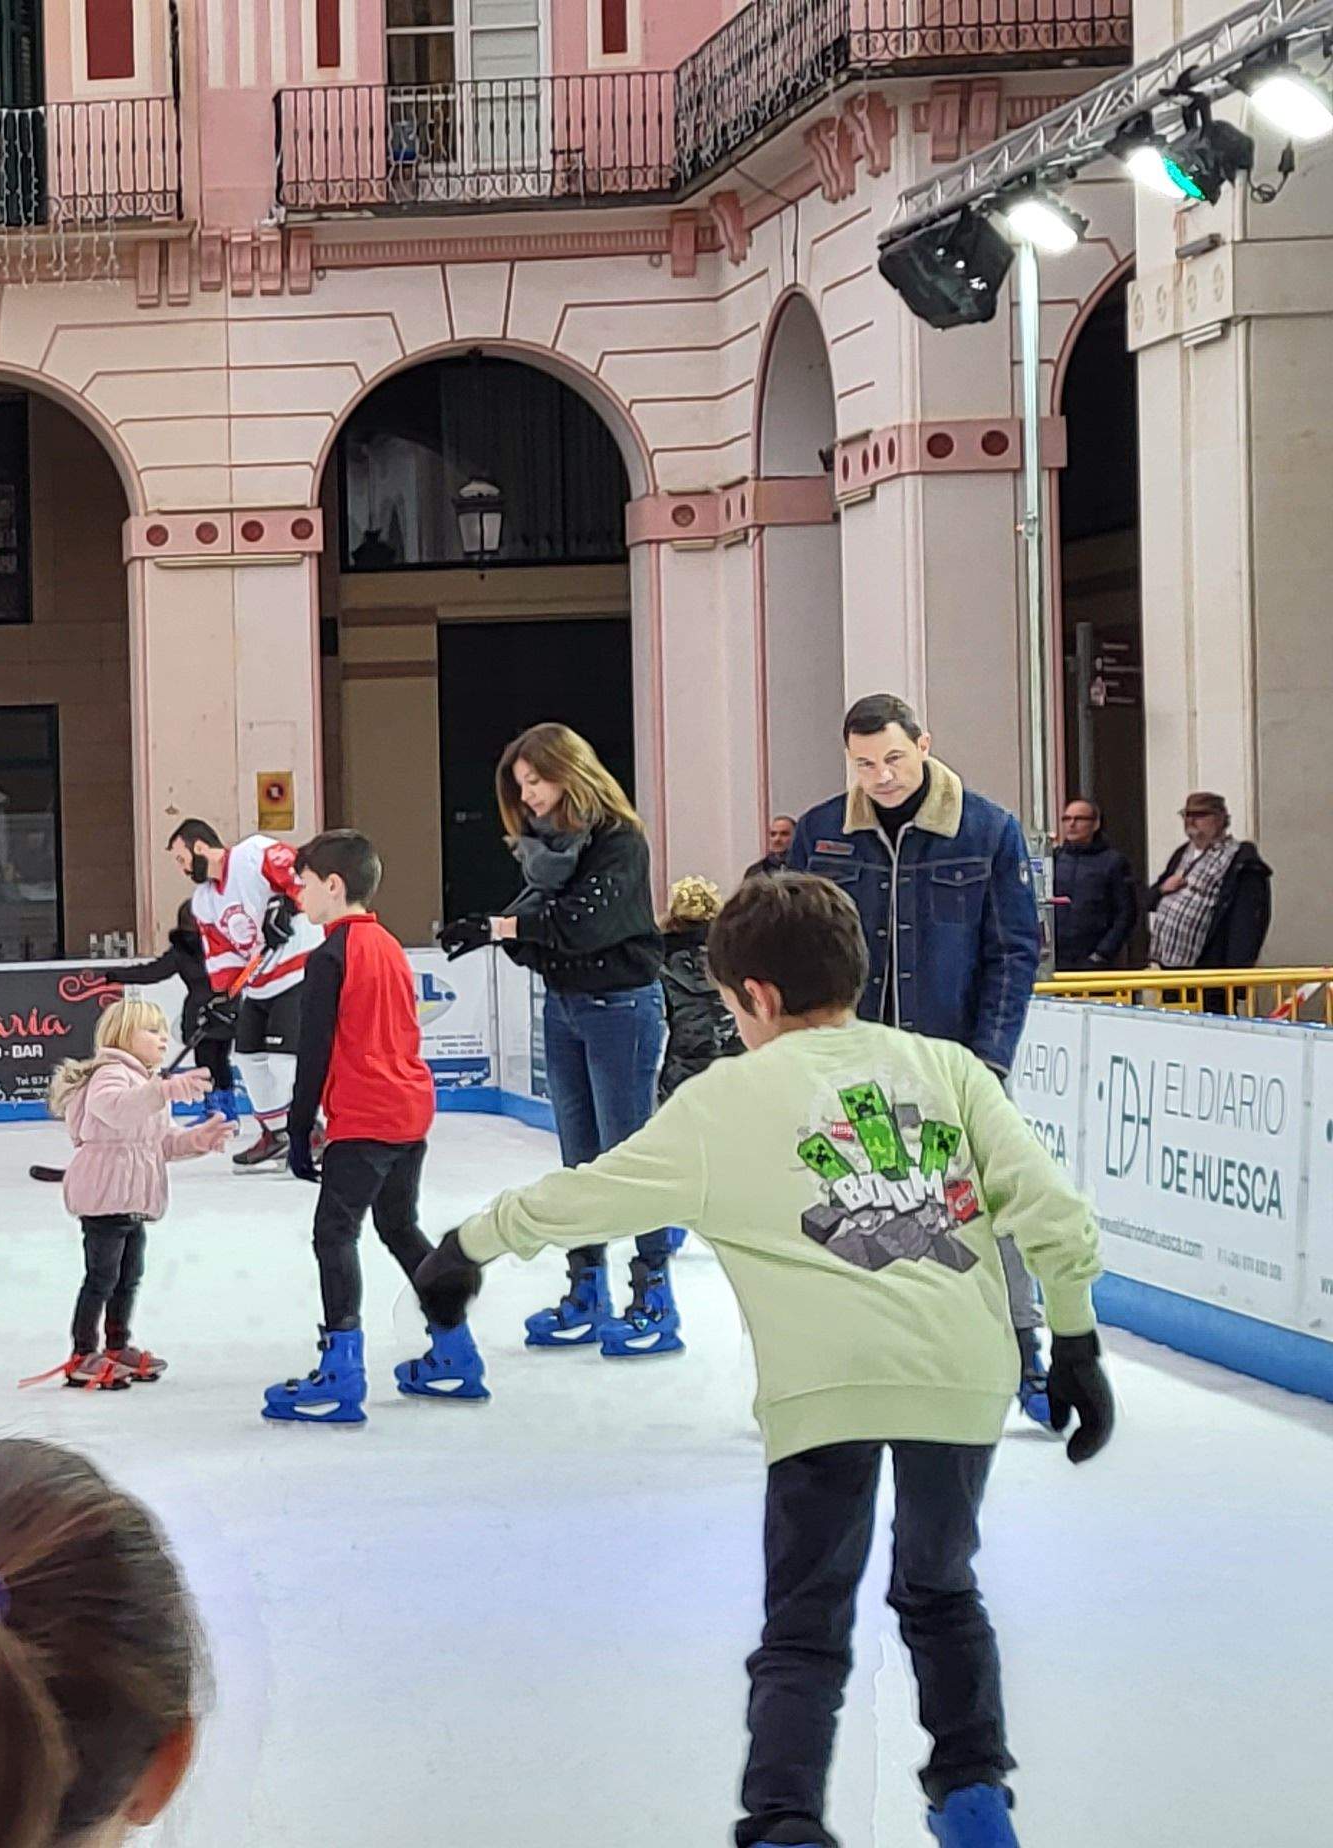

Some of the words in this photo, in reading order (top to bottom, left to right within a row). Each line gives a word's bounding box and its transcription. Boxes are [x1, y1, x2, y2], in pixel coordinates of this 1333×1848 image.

[11, 1044, 43, 1059] BAR
[1164, 1062, 1191, 1118] EL
[1197, 1067, 1285, 1136] DIARIO
[833, 1166, 946, 1214] BOOM
[1161, 1146, 1188, 1194] DE
[1192, 1152, 1284, 1220] HUESCA
